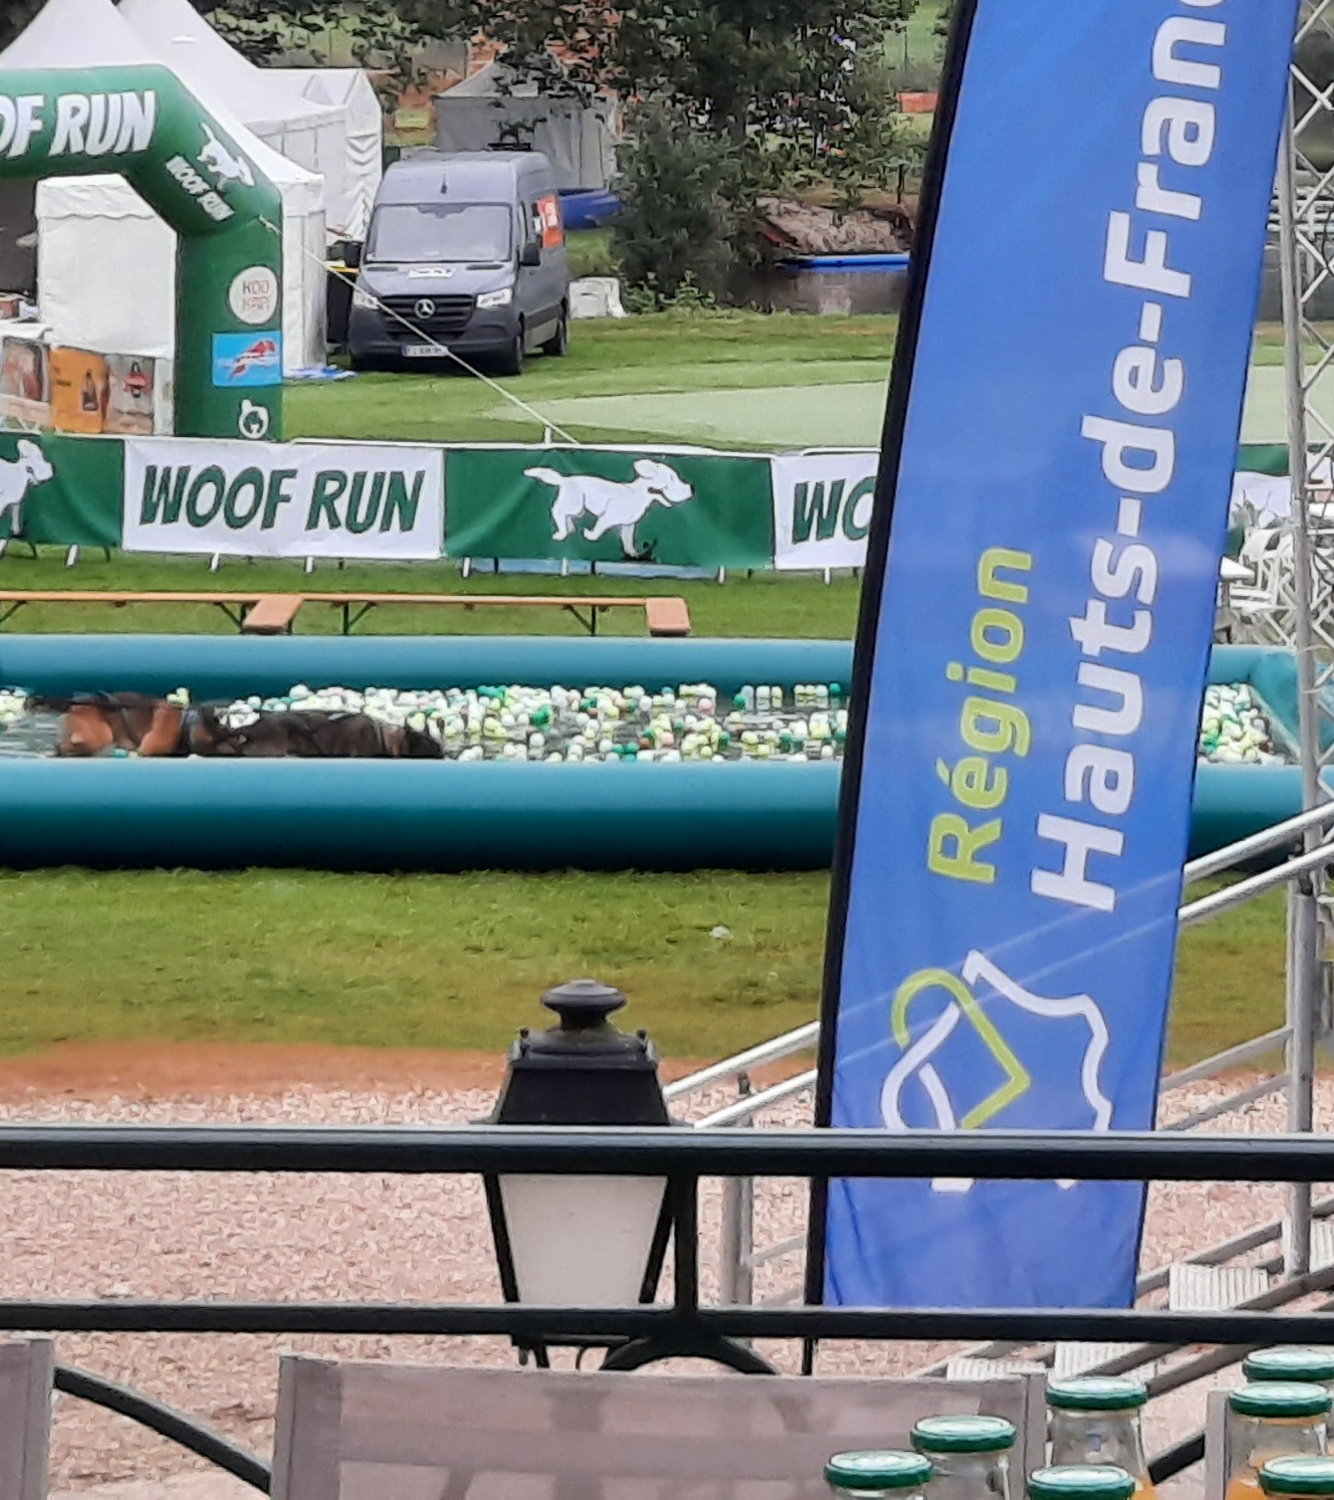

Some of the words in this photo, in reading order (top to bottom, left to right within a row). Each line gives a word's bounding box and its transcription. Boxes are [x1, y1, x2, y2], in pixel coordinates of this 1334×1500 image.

[48, 90, 155, 156] RUN
[165, 155, 211, 195] WOOF
[196, 191, 235, 221] RUN
[140, 464, 298, 530] WOOF
[305, 470, 426, 534] RUN
[792, 476, 876, 544] WO
[928, 545, 1033, 884] Région
